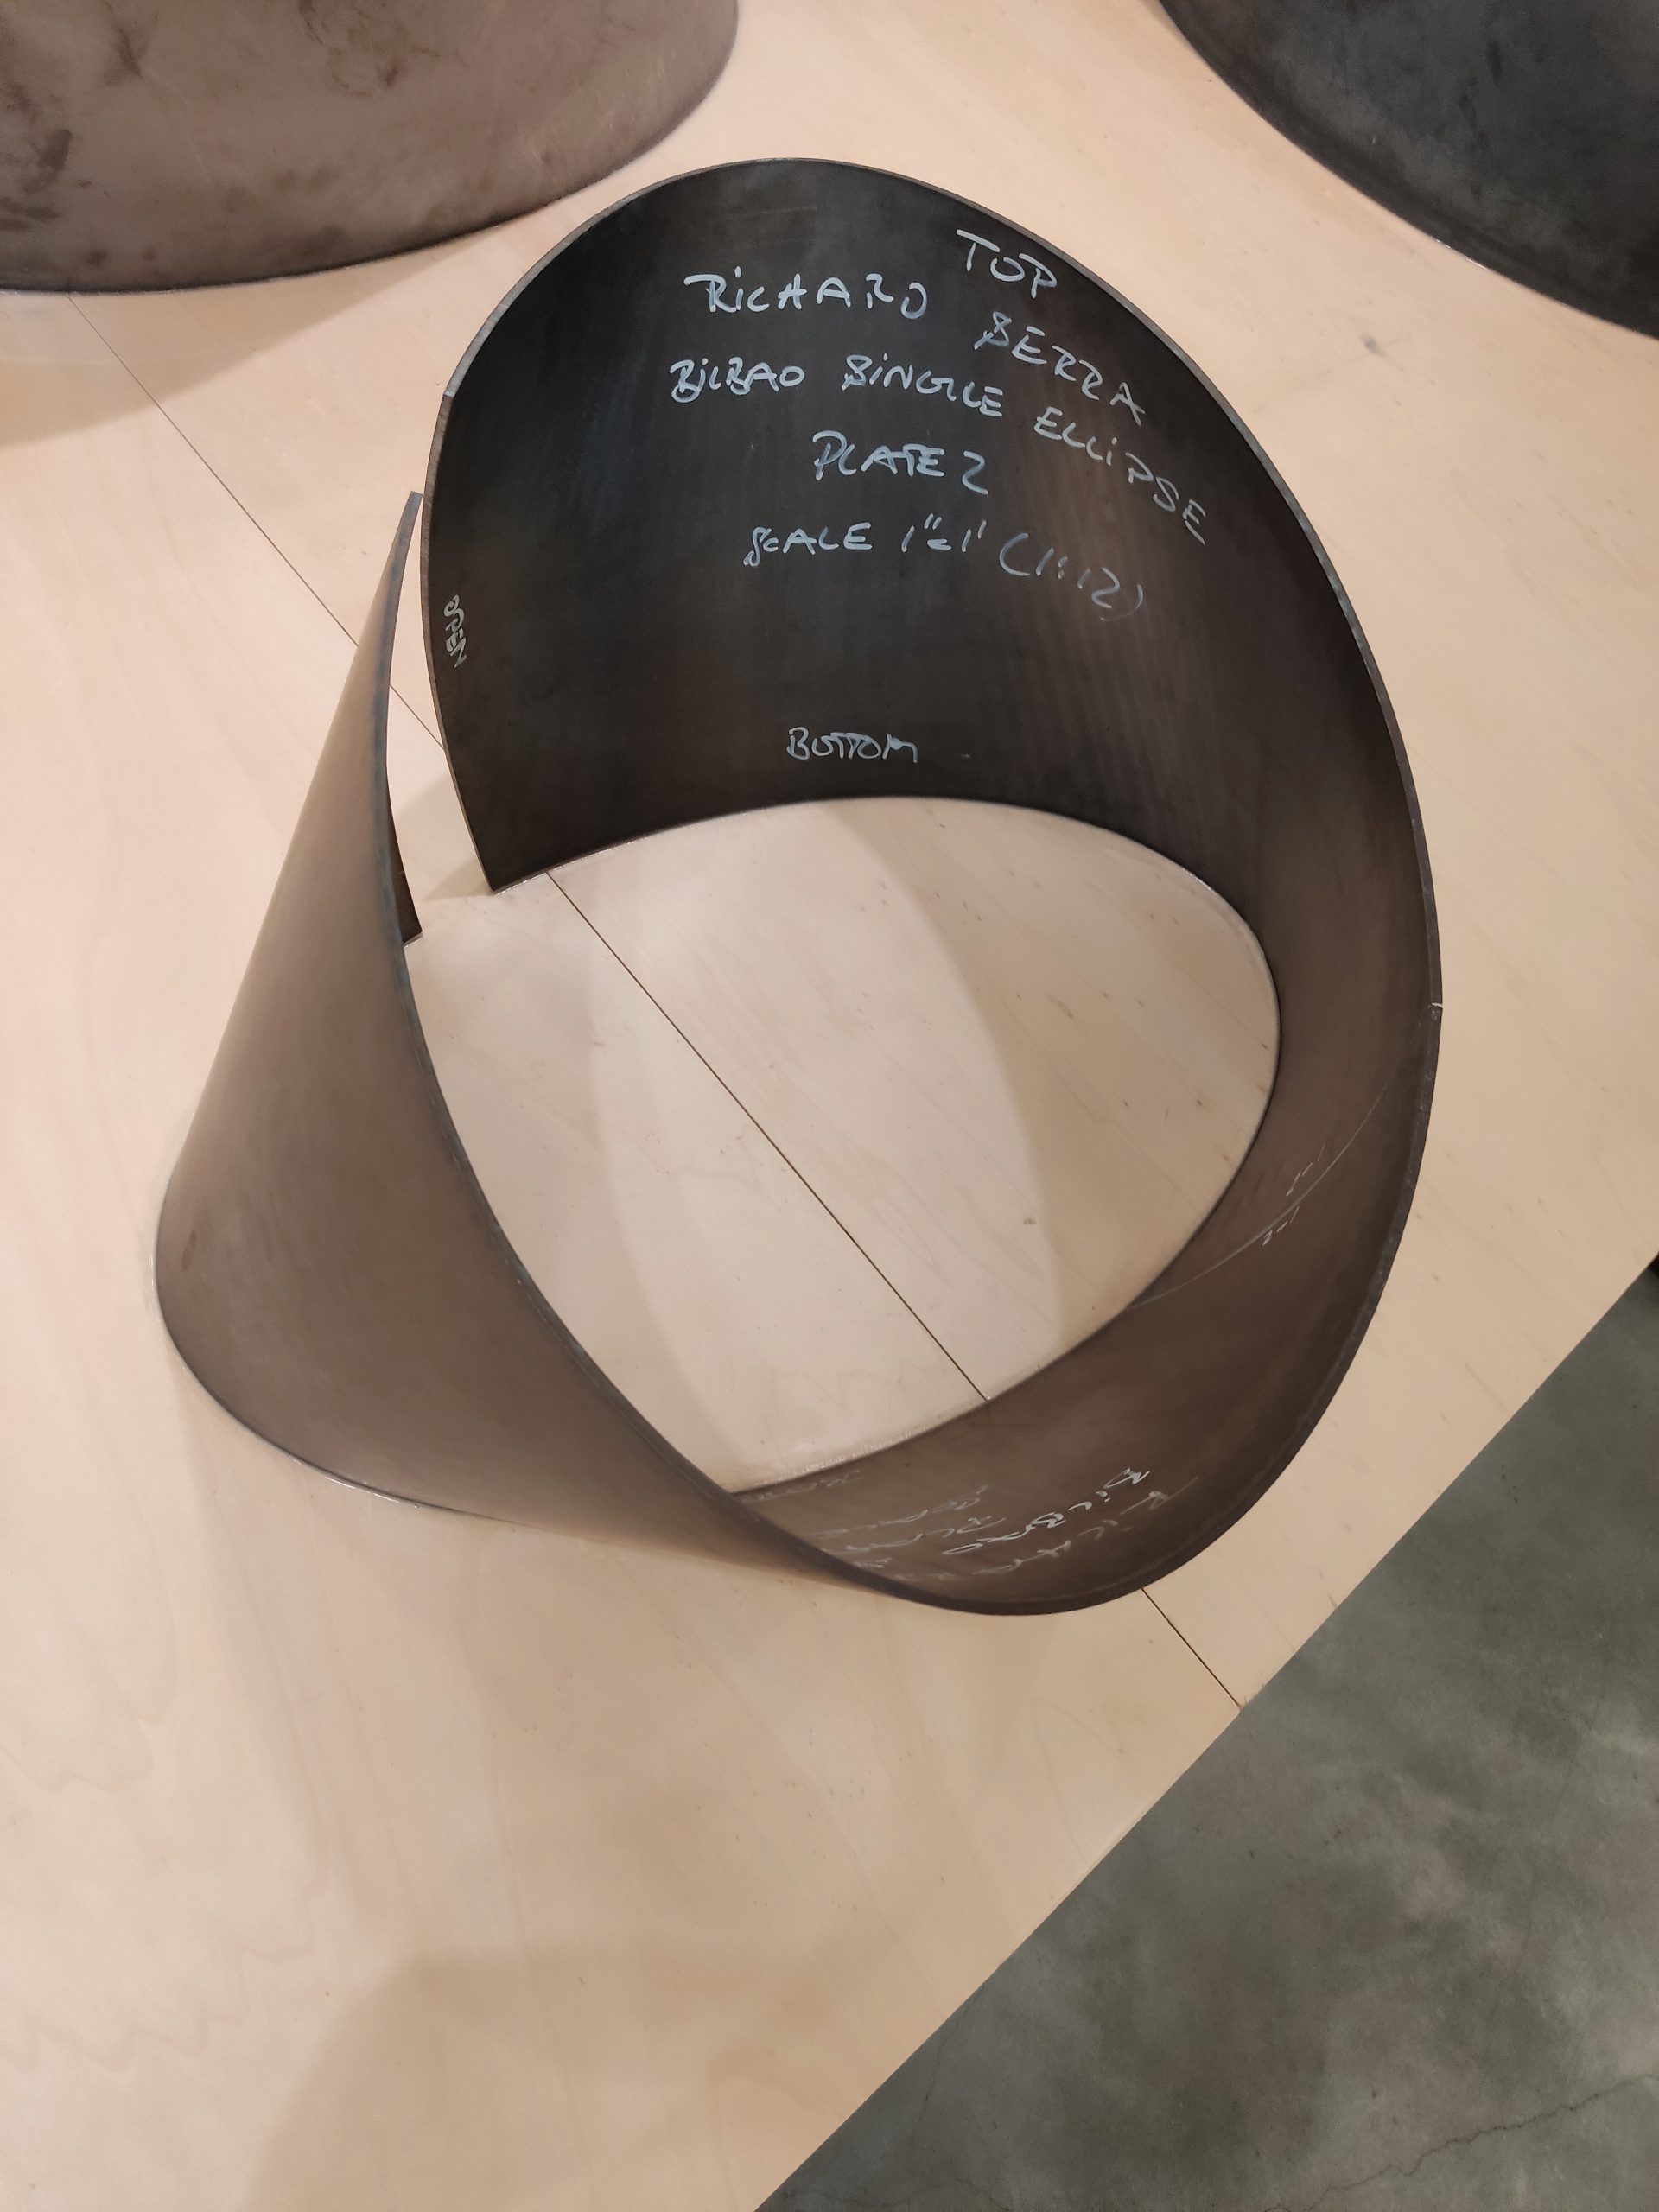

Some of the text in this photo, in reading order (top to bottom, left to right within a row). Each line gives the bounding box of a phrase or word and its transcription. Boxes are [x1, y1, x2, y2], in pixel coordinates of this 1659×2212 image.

[956, 228, 1058, 299] TOP
[973, 310, 1146, 427] SERRA
[811, 429, 945, 481] PLATE
[742, 521, 873, 568] SCALE
[443, 594, 467, 669] OPEN
[785, 726, 918, 764] BOTTOM
